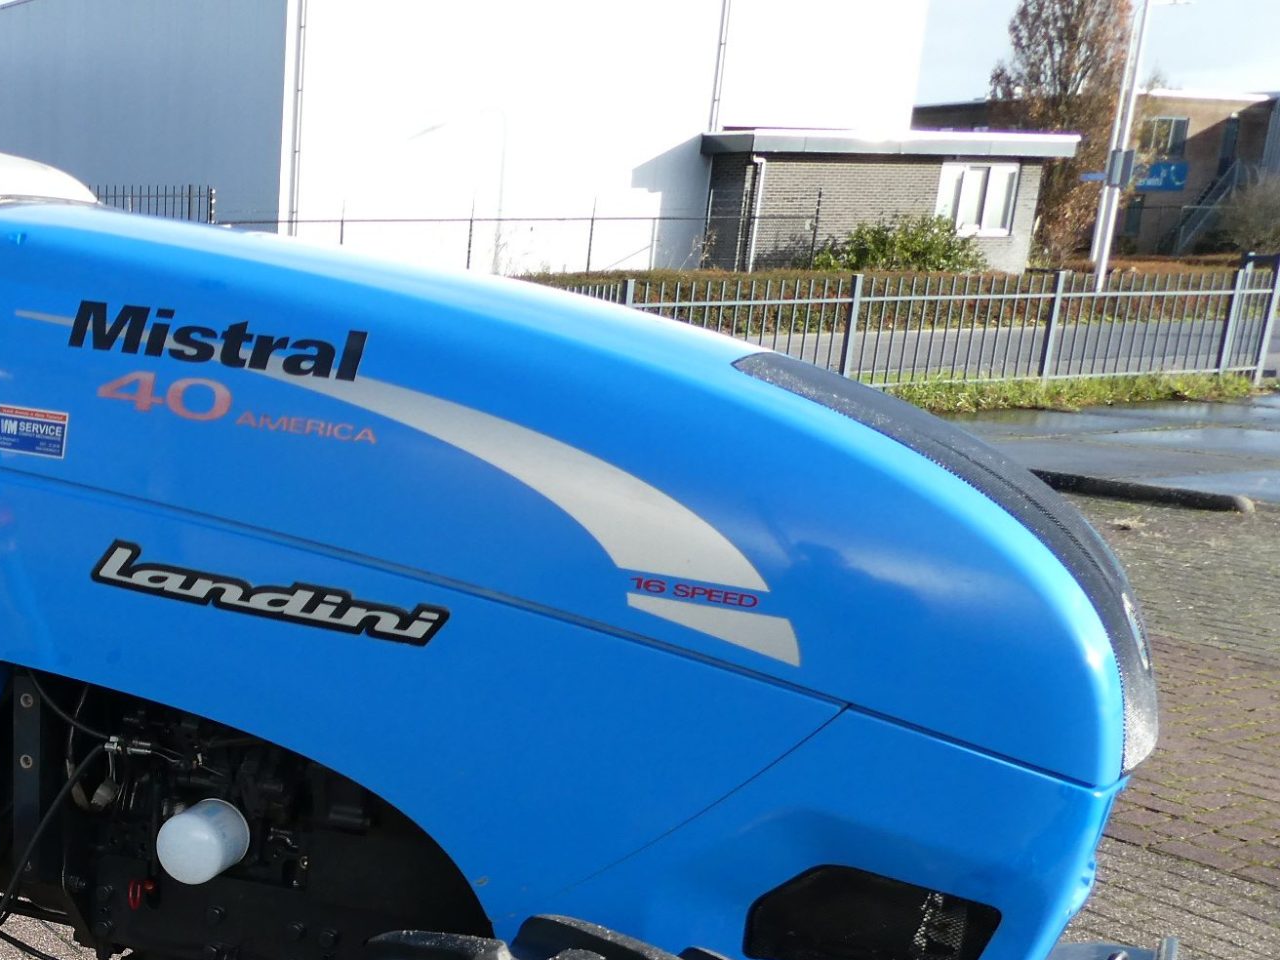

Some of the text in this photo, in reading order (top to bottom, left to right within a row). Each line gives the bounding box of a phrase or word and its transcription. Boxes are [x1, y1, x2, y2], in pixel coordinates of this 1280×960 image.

[68, 300, 368, 382] Mistral
[19, 421, 63, 437] SERVICE
[97, 371, 377, 445] 40 AMERICA
[93, 541, 449, 645] Landini
[629, 576, 760, 609] 16 SPEED
